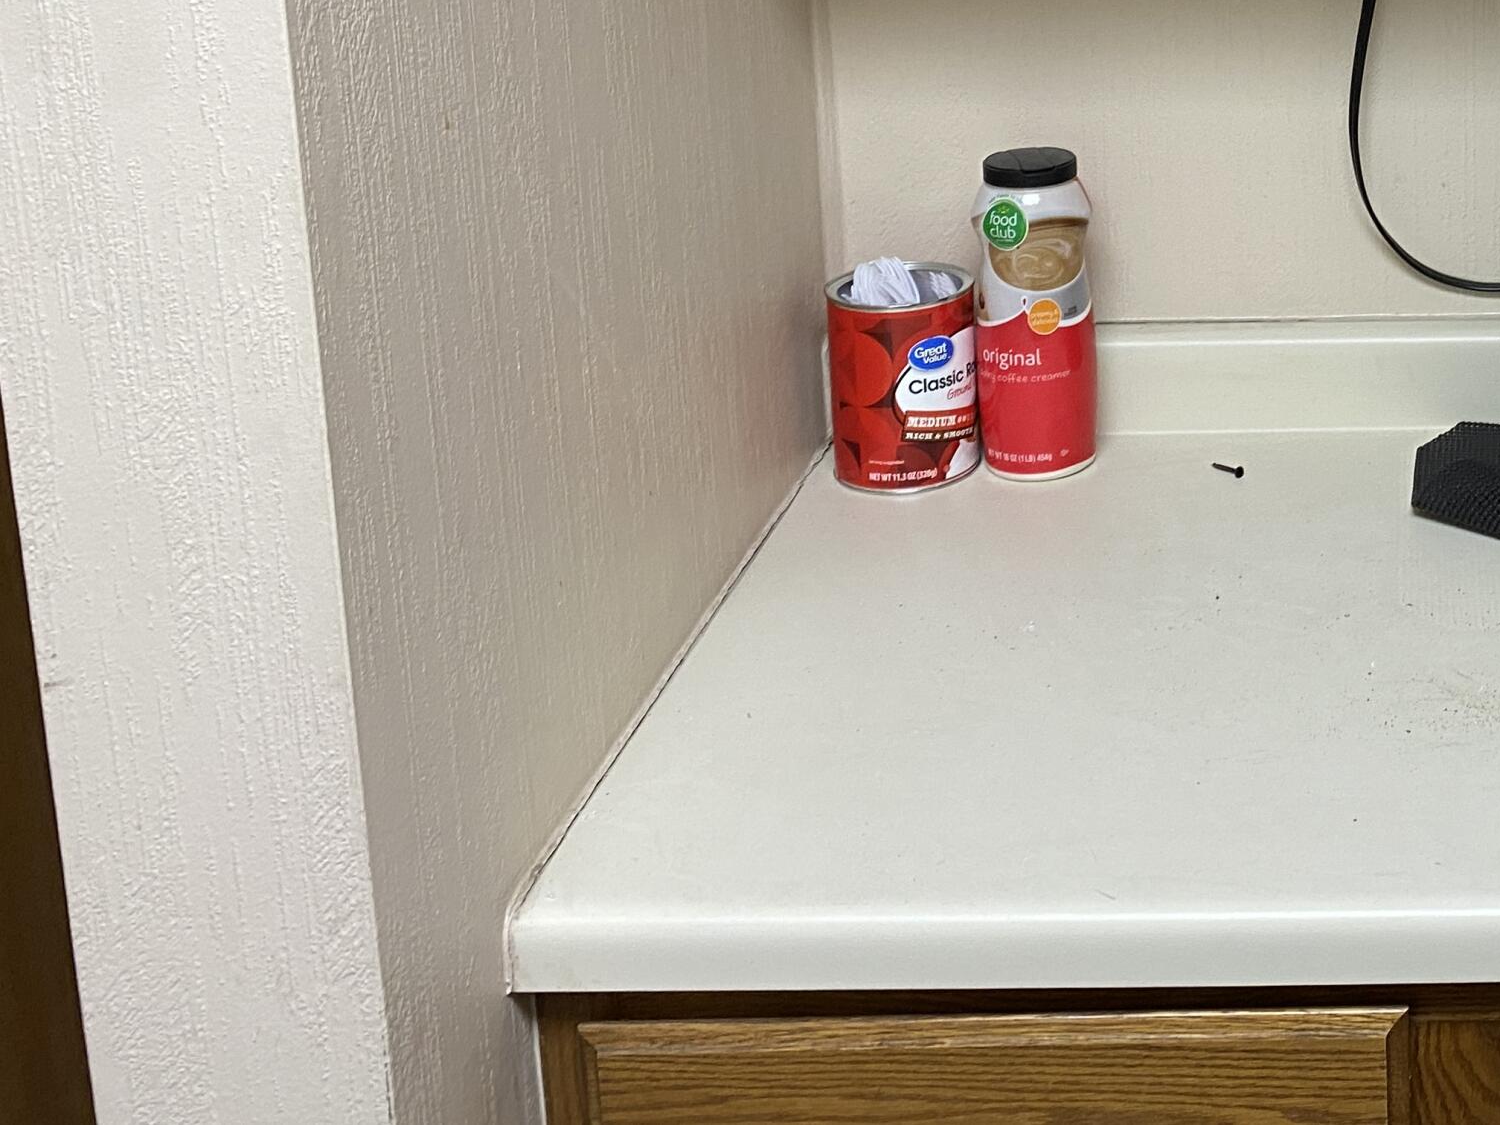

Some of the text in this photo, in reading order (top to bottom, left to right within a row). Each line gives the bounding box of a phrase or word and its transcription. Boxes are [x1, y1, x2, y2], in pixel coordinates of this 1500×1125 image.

[988, 210, 1018, 226] food
[989, 225, 1017, 239] club
[914, 342, 948, 359] Great
[923, 353, 948, 365] Value
[908, 369, 964, 395] Classic
[997, 372, 1028, 384] coffee
[1030, 369, 1072, 383] creamer
[906, 414, 957, 428] MEDIUM
[905, 431, 933, 440] RICH
[943, 427, 974, 440] SMOOTH
[1036, 452, 1053, 462] 454g
[868, 472, 881, 481] NET
[881, 473, 893, 482] WT
[892, 473, 907, 482] 11.3
[907, 471, 917, 481] OZ
